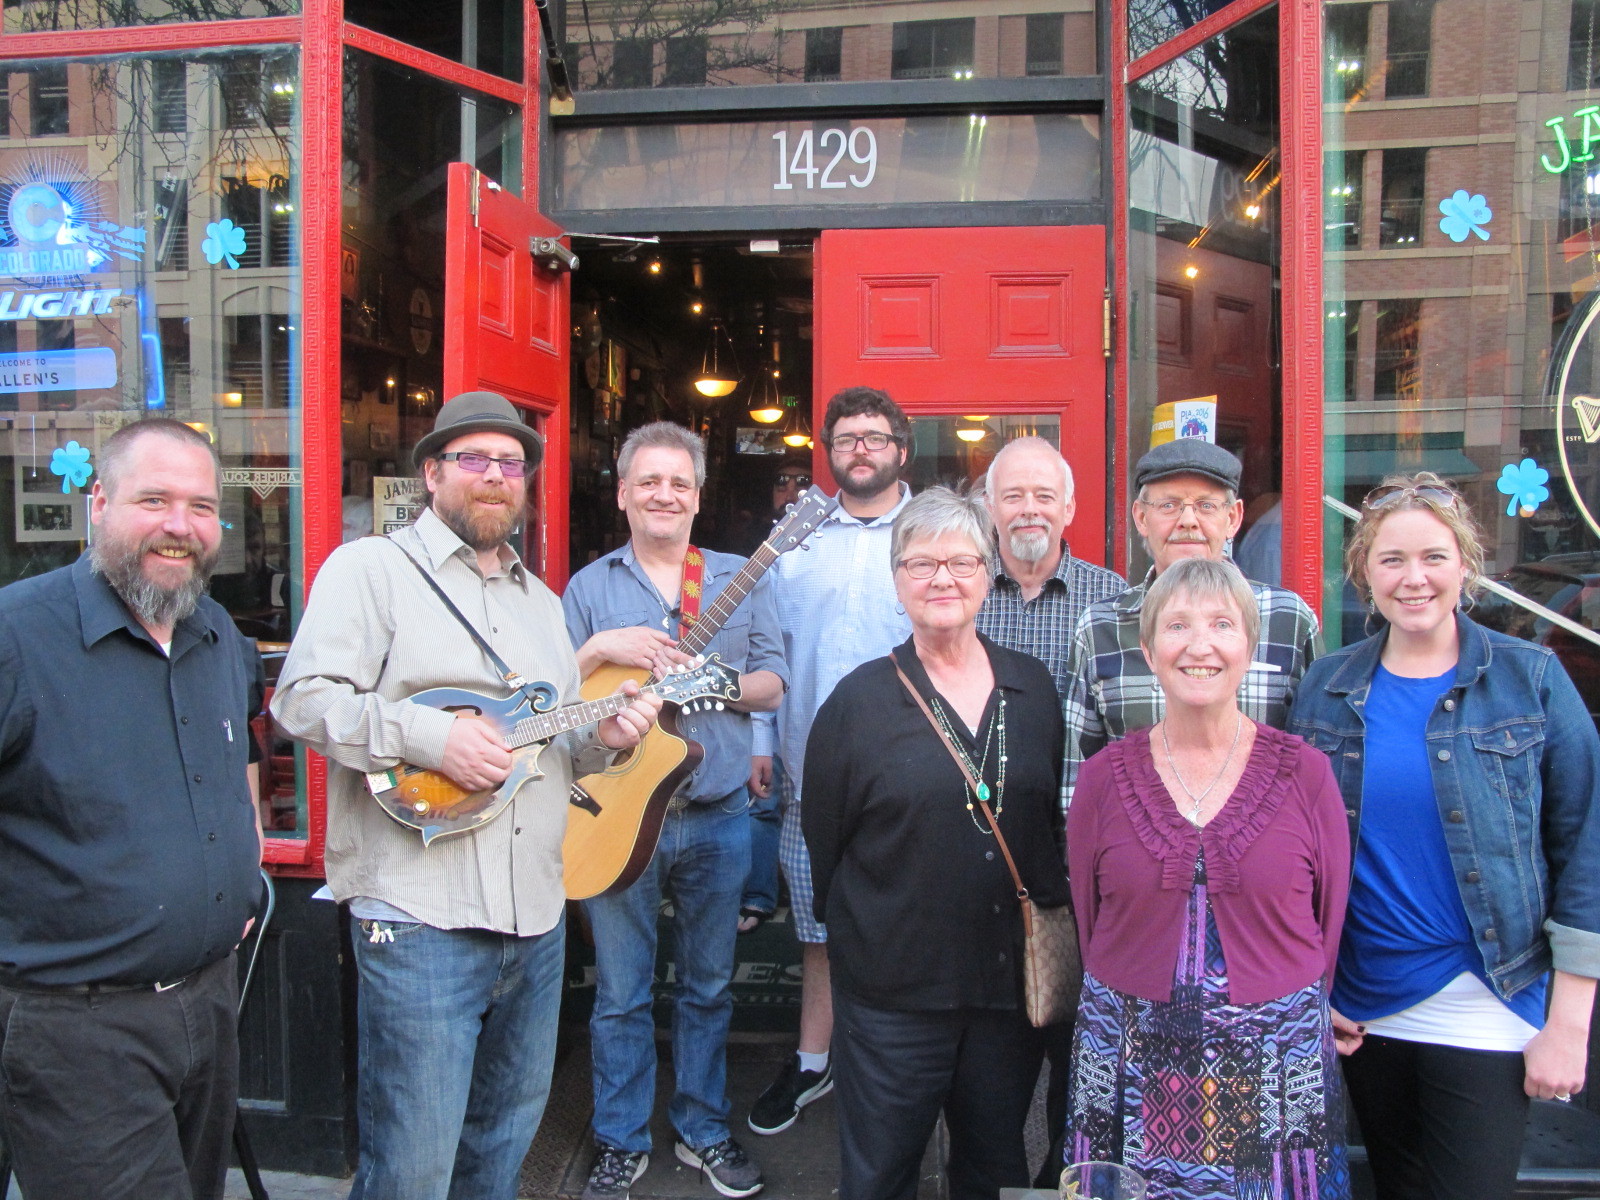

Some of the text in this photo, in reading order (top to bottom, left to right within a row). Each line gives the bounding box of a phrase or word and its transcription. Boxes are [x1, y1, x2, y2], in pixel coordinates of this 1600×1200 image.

[772, 126, 878, 190] 1429
[0, 249, 86, 273] COLORADO
[36, 358, 46, 366] TO
